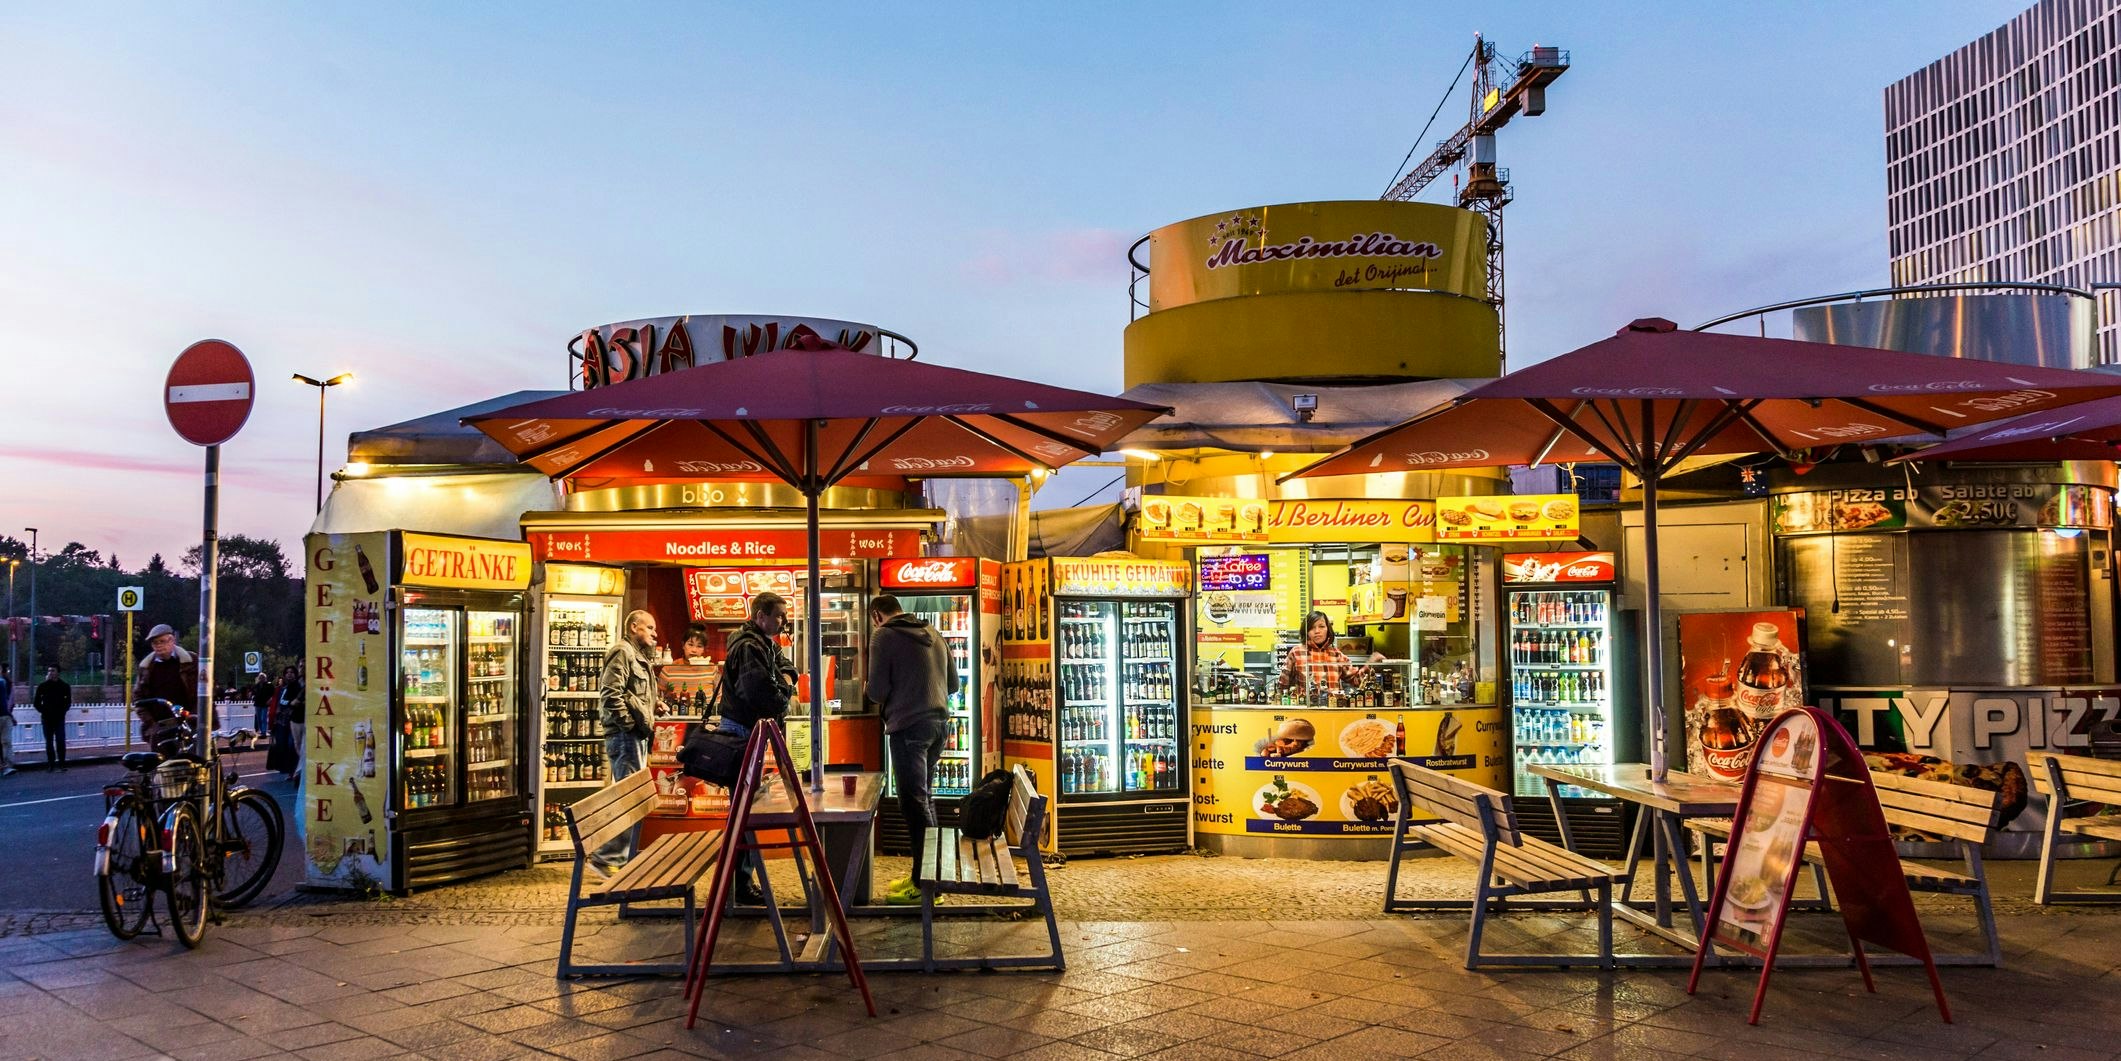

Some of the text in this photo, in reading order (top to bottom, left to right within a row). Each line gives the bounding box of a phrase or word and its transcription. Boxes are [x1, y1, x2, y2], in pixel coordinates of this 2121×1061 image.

[1206, 231, 1444, 270] Maximilian
[1334, 269, 1360, 287] det
[581, 317, 695, 390] ASIA
[1570, 386, 1685, 396] Coca-Cola
[1867, 381, 1985, 392] Coca-Cola
[586, 407, 707, 418] Coca-Cola
[880, 403, 992, 415] Coca-Cola
[1828, 489, 1886, 503] Pizza
[1893, 488, 1919, 501] ab
[1942, 484, 2034, 499] Salate ab
[1287, 501, 1391, 527] Berliner
[1961, 502, 2017, 523] 2,50€
[556, 540, 583, 551] WOK
[666, 541, 776, 555] Noodles & Rice
[859, 539, 885, 549] WOK
[409, 545, 517, 582] GETRÄNKE
[1224, 560, 1262, 573] Coffee
[1054, 559, 1121, 581] GEKÜHLTE
[1125, 561, 1191, 583] GETRÄNKE
[1567, 565, 1600, 577] Coca-Cola
[1229, 574, 1243, 584] to
[1246, 574, 1263, 585] go
[314, 547, 337, 823] GETRÄNKE
[1755, 703, 1775, 713] light
[1264, 759, 1309, 770] Currywurst
[1333, 760, 1378, 770] Currywurst
[1426, 758, 1468, 767] Rostbratwurst
[1274, 822, 1302, 832] Bulette
[1342, 824, 1371, 832] Bulette
